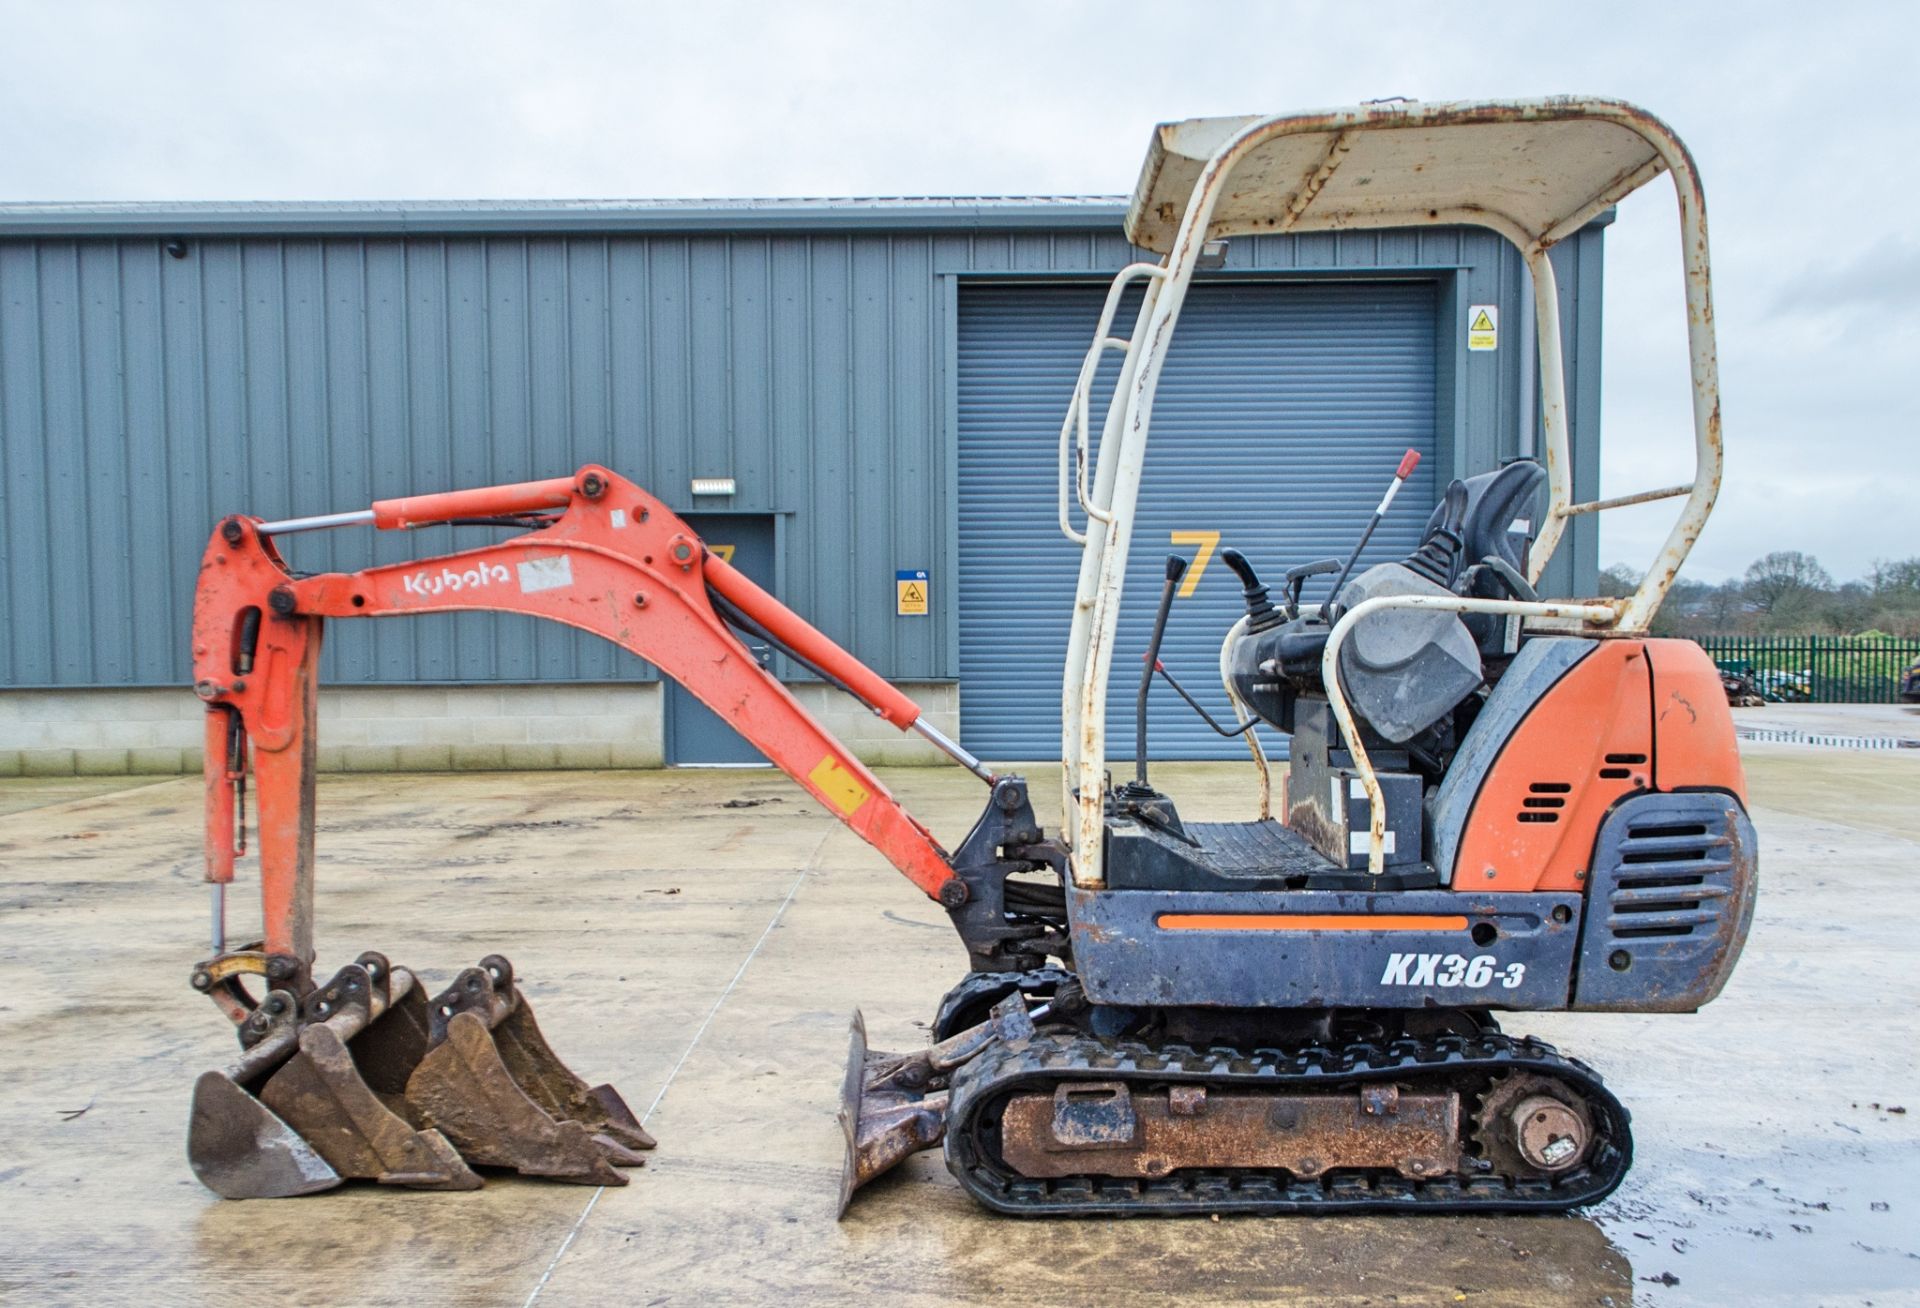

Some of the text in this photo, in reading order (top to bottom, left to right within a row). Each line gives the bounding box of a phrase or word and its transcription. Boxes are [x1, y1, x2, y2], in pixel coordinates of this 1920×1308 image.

[403, 561, 510, 595] Kubota
[1171, 529, 1220, 597] 7
[1380, 953, 1526, 988] KX36-3
